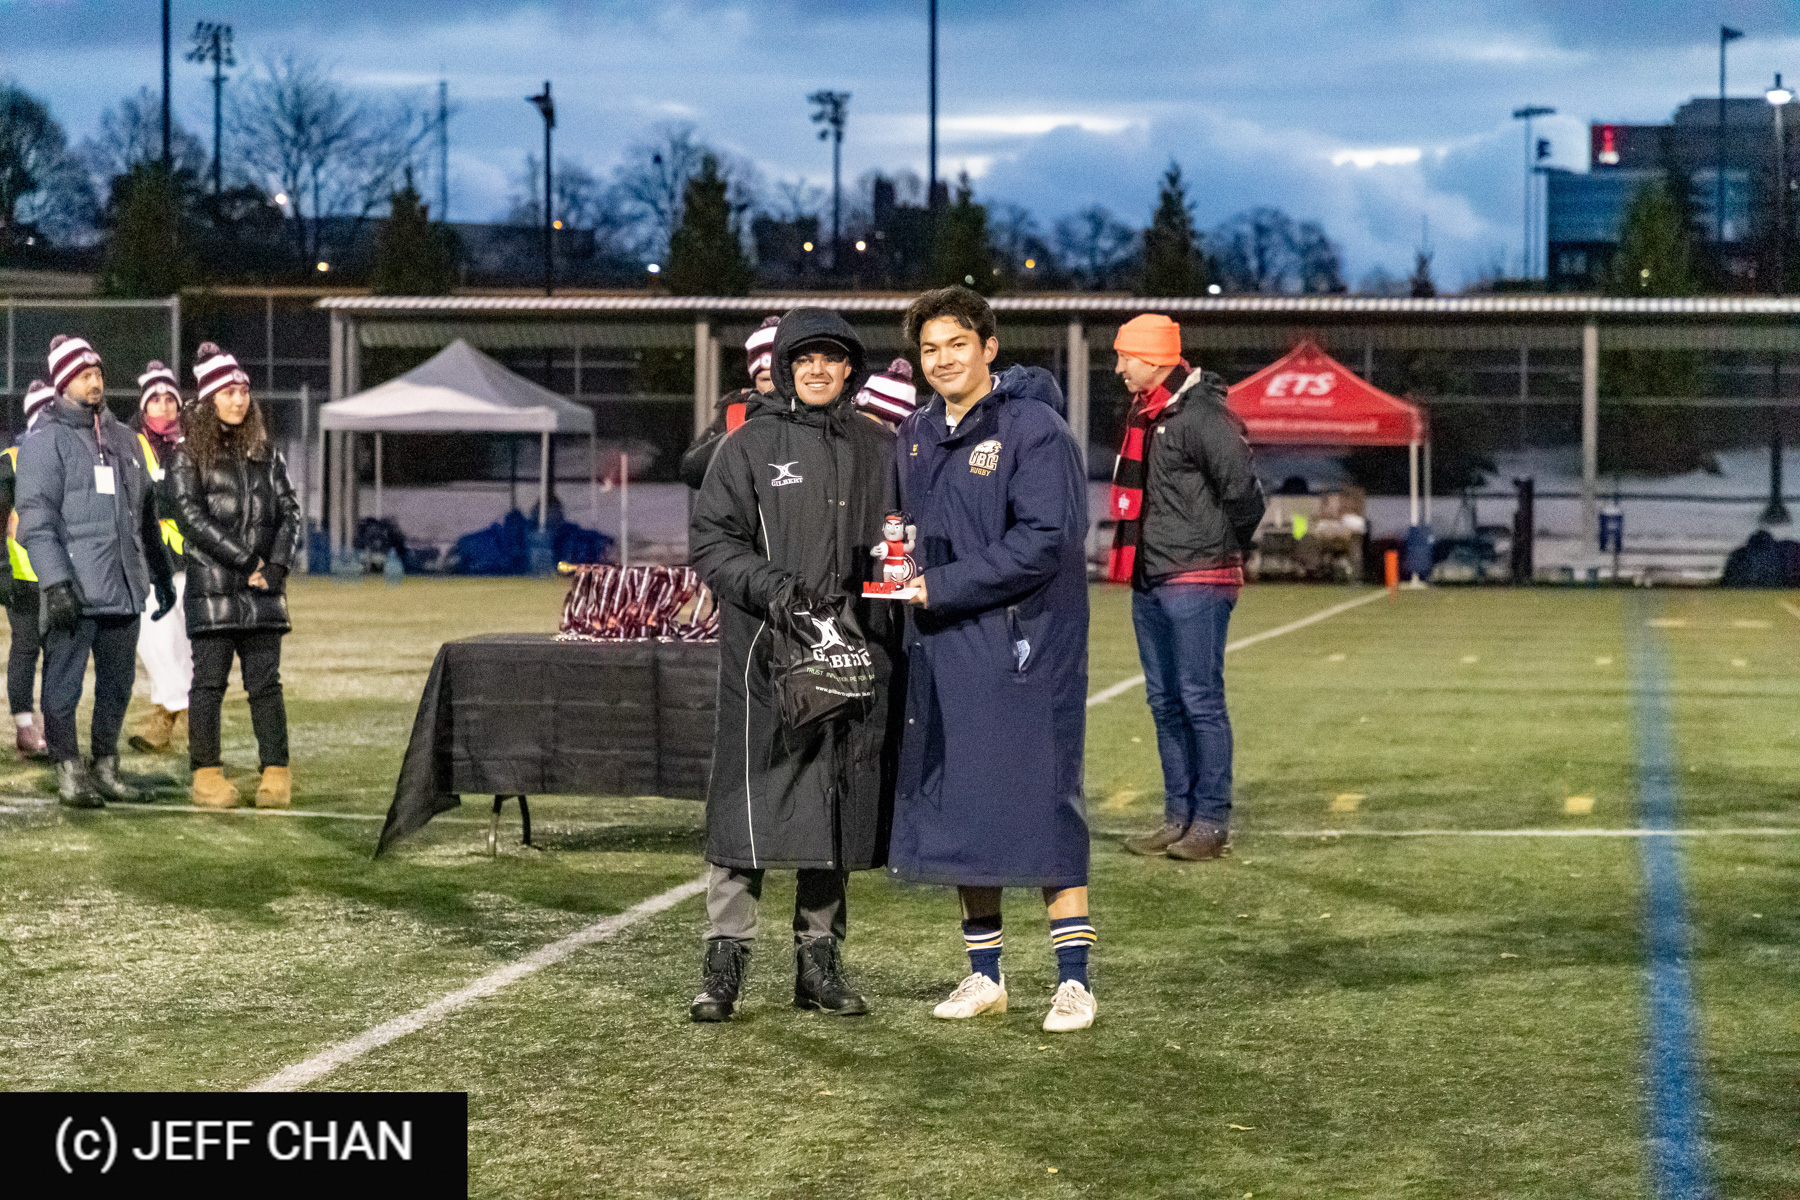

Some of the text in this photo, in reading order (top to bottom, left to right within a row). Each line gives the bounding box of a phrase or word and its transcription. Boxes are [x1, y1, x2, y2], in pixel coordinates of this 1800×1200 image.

[1264, 370, 1337, 397] ETS
[969, 450, 999, 471] UBC
[970, 466, 991, 477] RUGBY
[771, 477, 803, 487] GILBERT
[863, 581, 897, 594] MVP
[806, 667, 824, 676] TRUST
